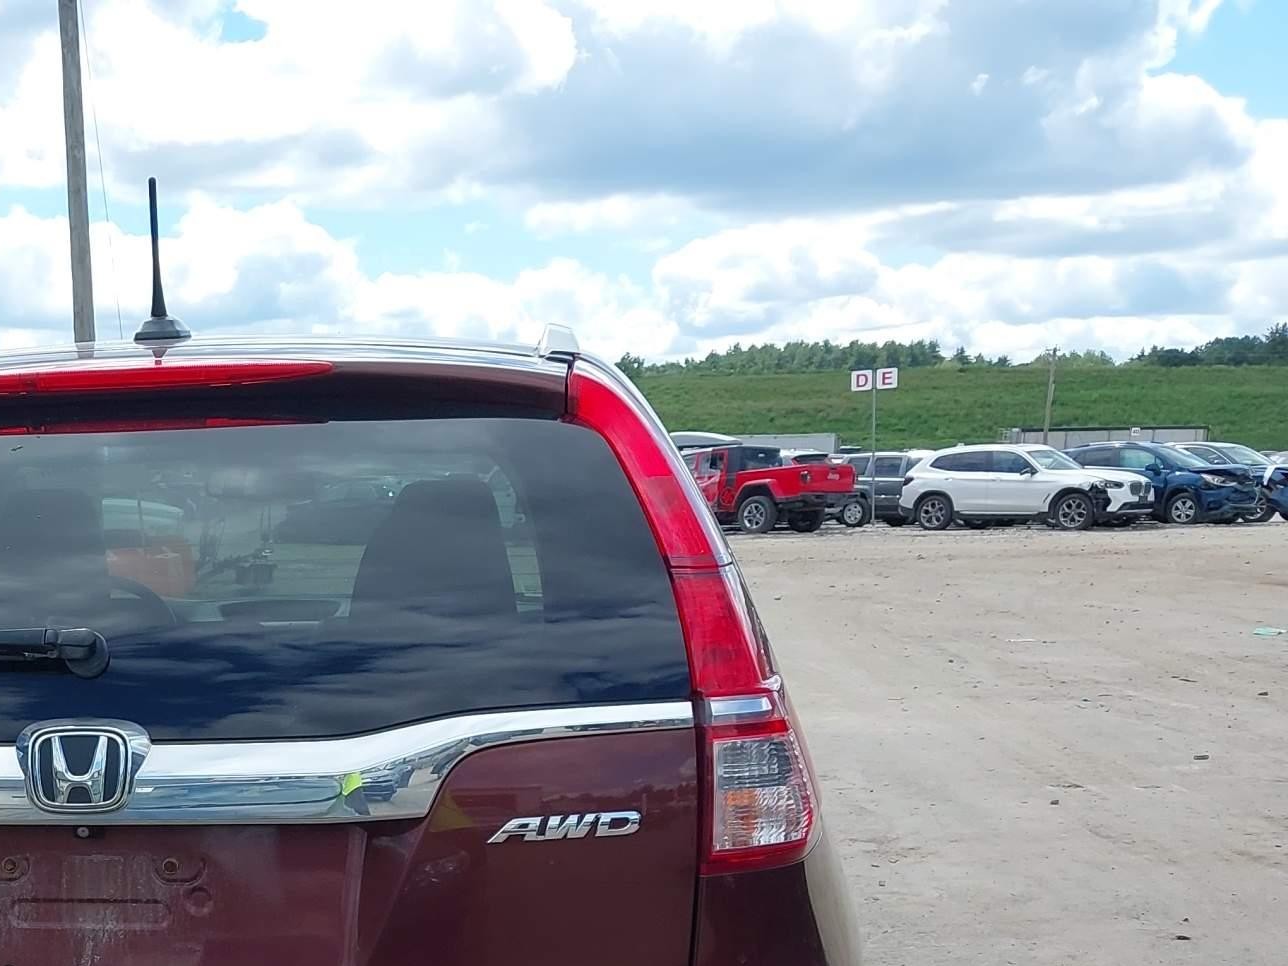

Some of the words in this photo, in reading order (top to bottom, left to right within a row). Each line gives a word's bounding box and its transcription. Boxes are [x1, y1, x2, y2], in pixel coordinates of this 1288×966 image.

[856, 373, 869, 388] D
[881, 371, 893, 385] E
[487, 811, 642, 844] AWD
